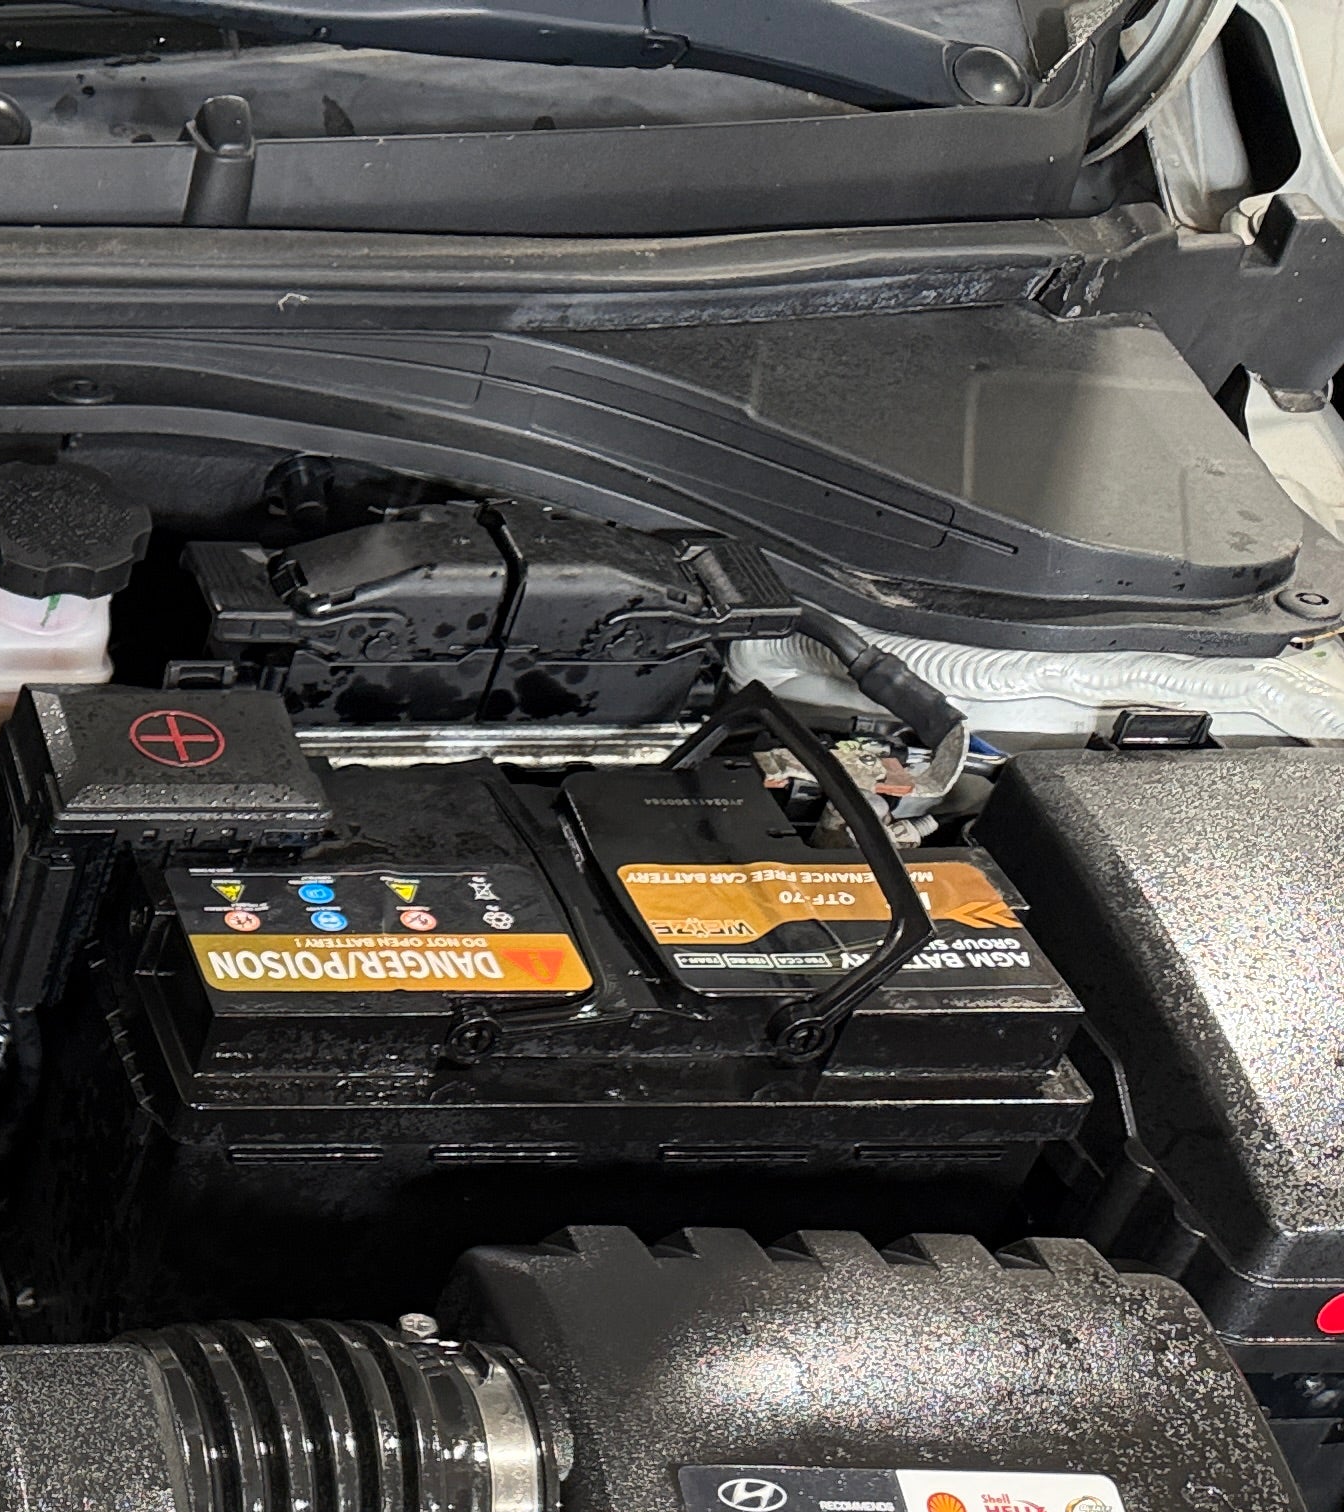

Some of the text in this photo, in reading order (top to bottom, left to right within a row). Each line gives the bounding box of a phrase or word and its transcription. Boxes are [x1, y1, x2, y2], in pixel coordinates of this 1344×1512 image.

[626, 869, 934, 884] MAENANCE FREE CAR BATTERY
[779, 890, 856, 906] QTF-70
[305, 937, 375, 949] BATTERY
[376, 937, 425, 948] OPEN
[426, 937, 461, 948] NOT
[462, 937, 489, 948] DO
[952, 937, 1021, 950] GROUP
[208, 950, 505, 979] DANGER/POISON
[841, 951, 1031, 970] AGM BATRY
[980, 1494, 1011, 1503] Shell
